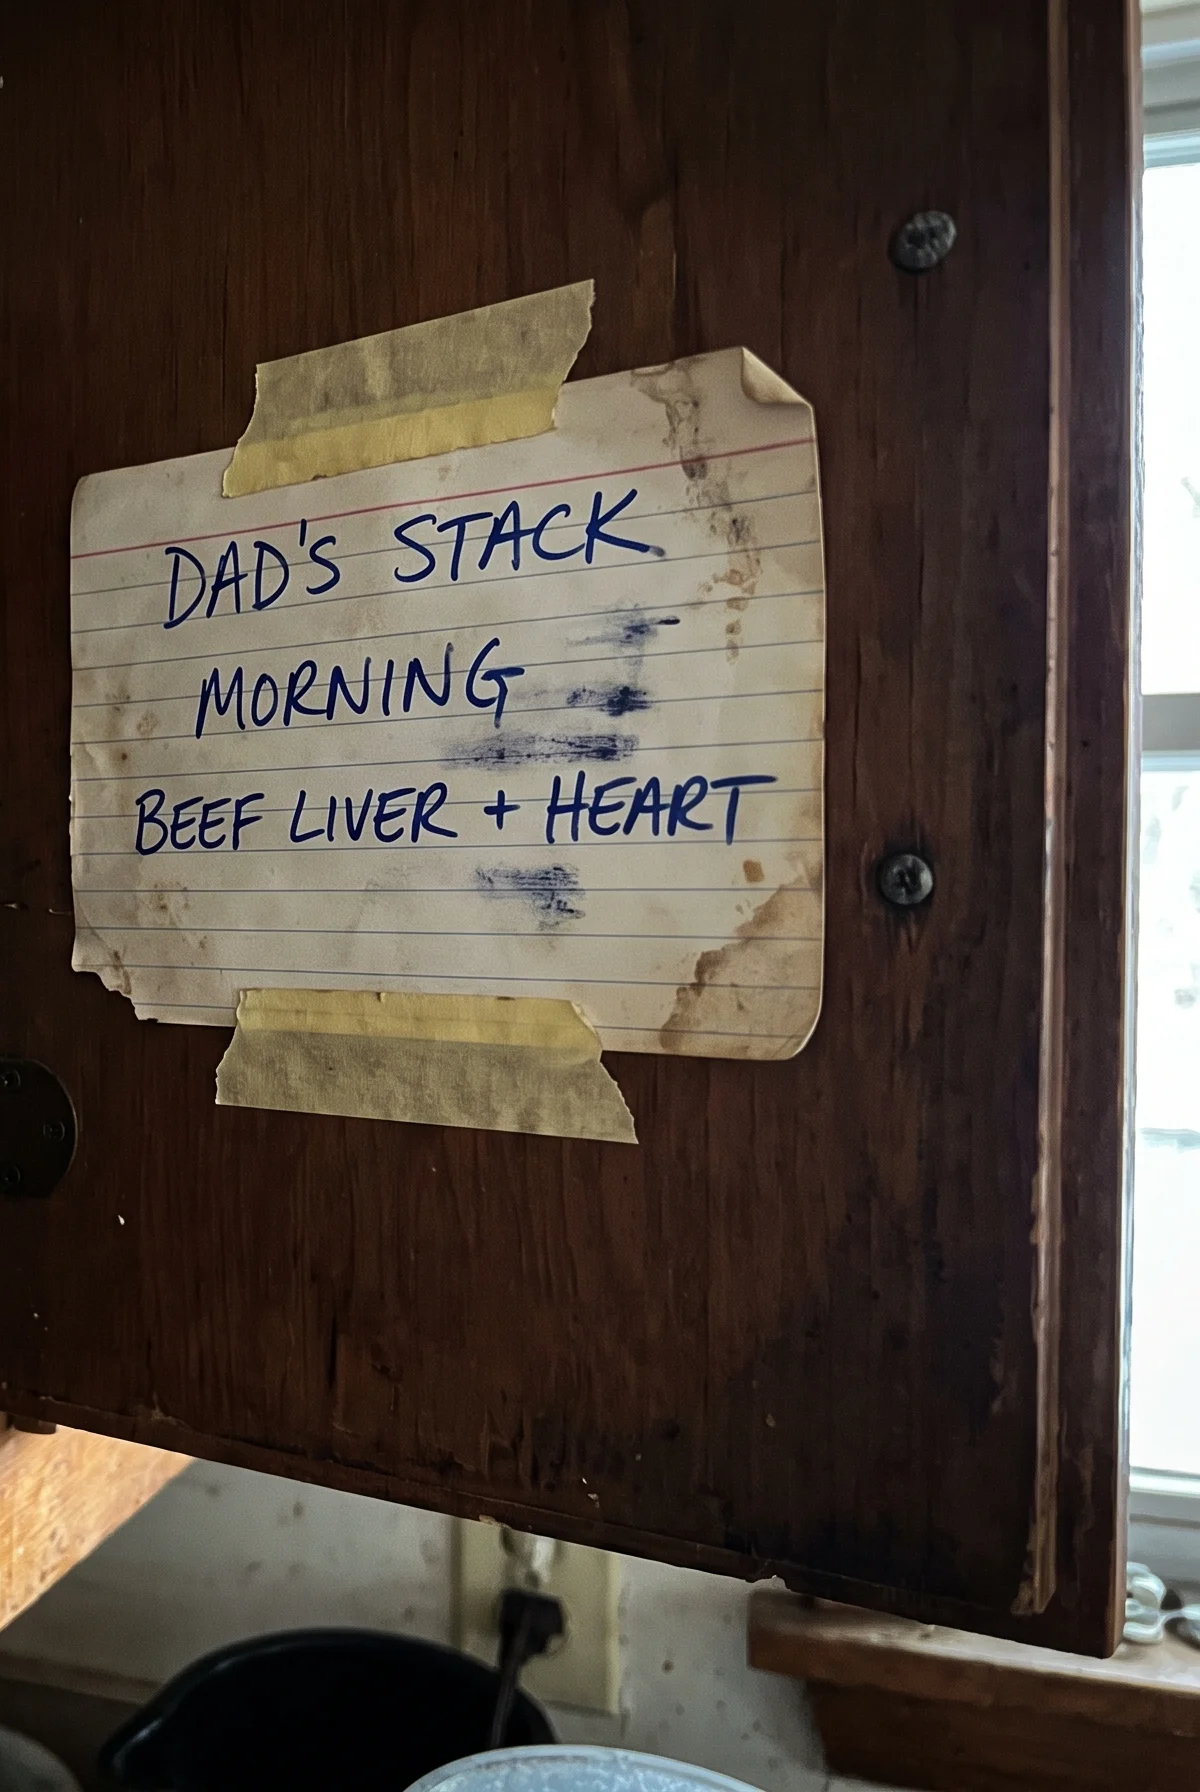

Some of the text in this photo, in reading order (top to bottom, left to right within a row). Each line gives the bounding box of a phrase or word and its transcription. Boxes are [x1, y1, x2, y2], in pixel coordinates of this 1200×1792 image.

[162, 489, 660, 629] DAD'S STACK
[195, 638, 525, 738] MORNING
[135, 771, 778, 856] BEEF LIVER + HEART
